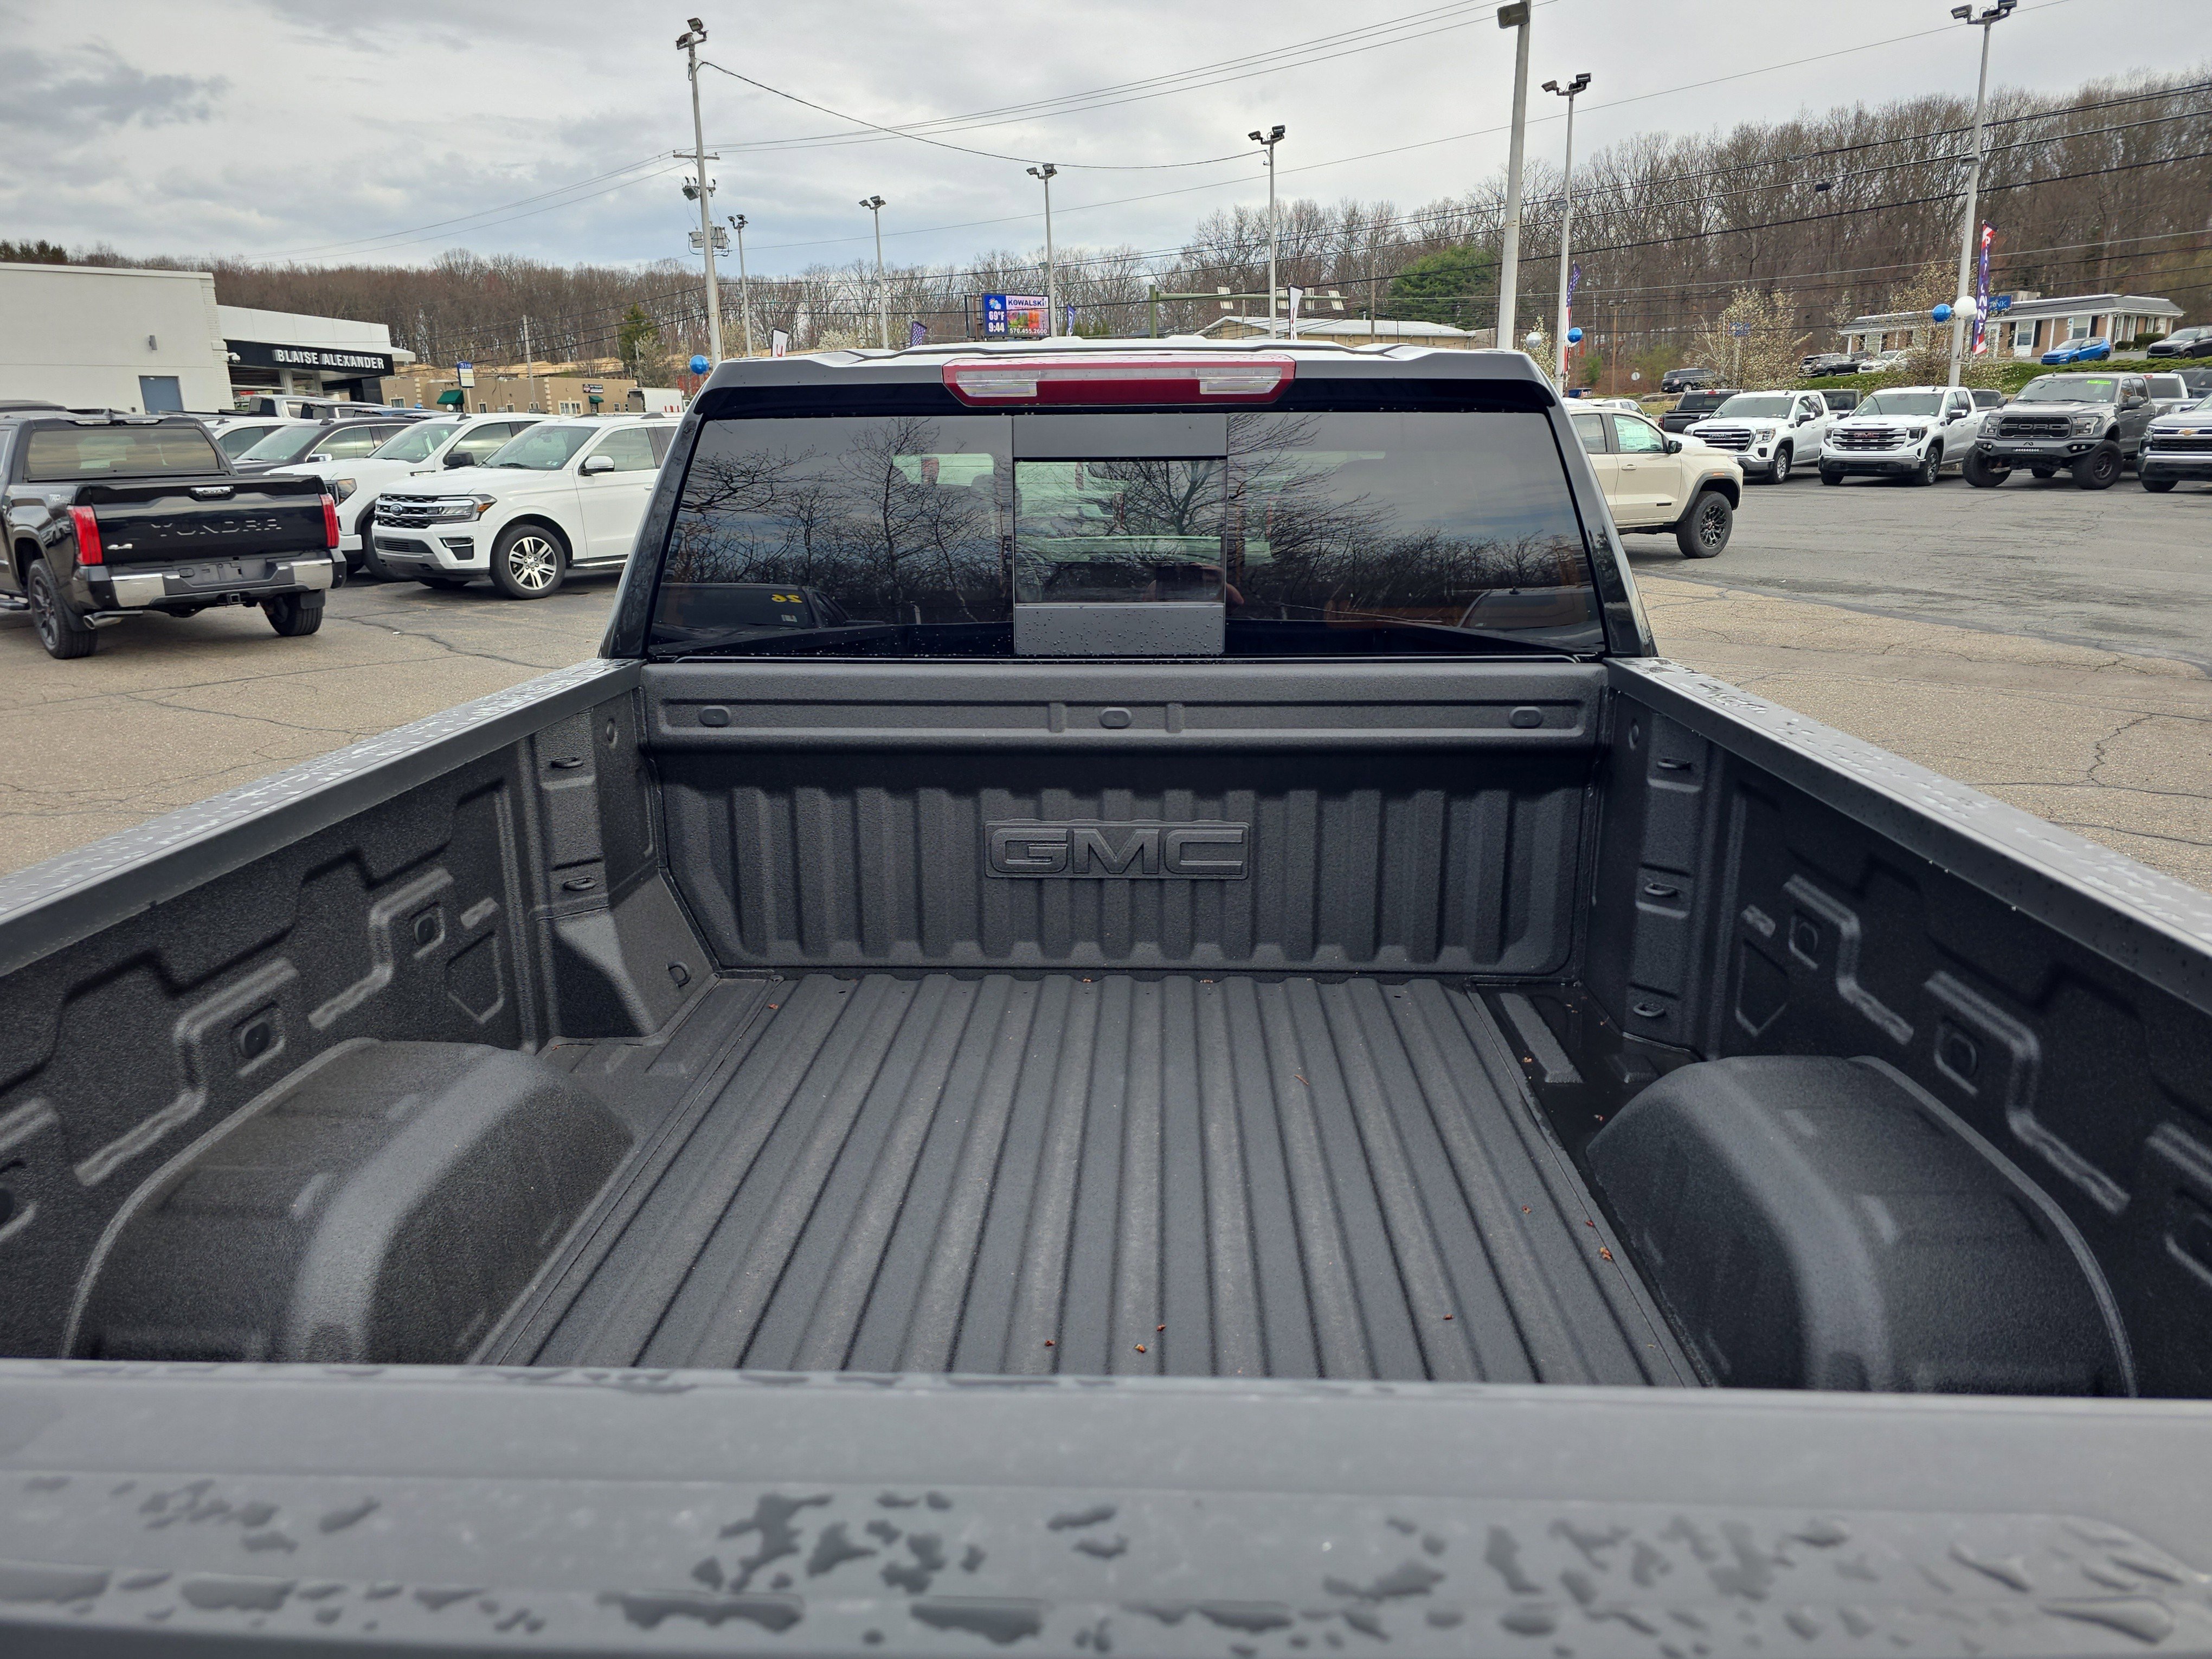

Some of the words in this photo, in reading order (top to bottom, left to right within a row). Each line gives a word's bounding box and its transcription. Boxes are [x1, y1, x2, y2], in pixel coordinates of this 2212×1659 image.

[1008, 298, 1045, 306] KOWALSKI
[988, 311, 1005, 320] 69°F
[988, 322, 1005, 332] 9:44
[273, 350, 319, 364] BLAISE
[320, 353, 384, 369] ALEXANDER
[990, 827, 1244, 874] GMC
